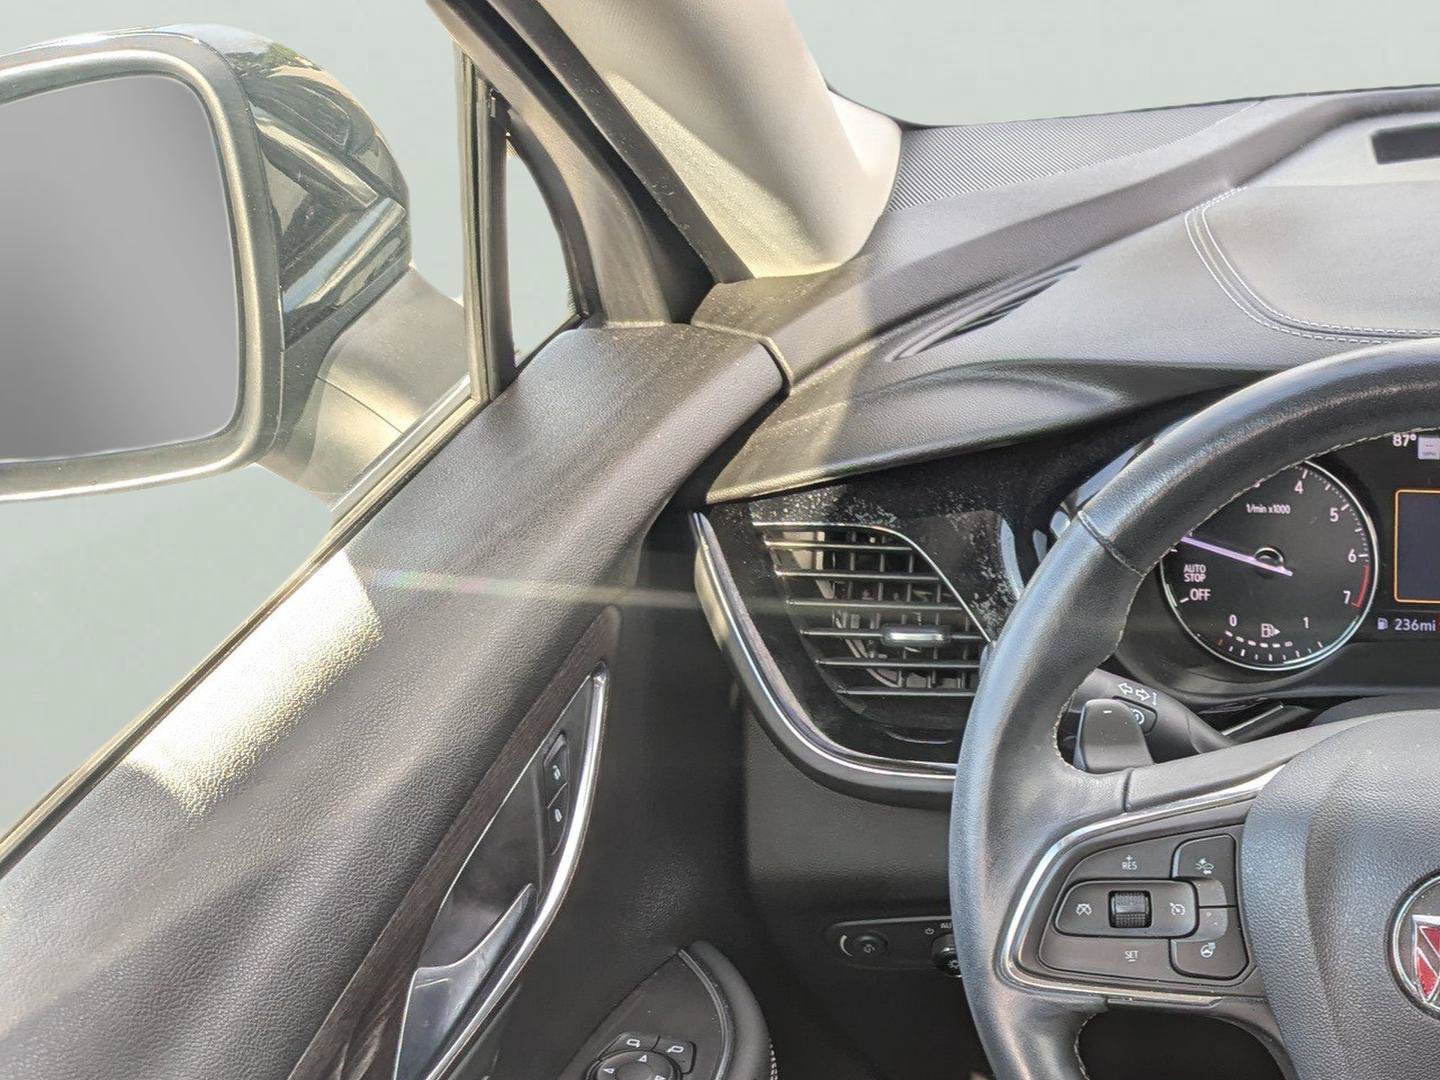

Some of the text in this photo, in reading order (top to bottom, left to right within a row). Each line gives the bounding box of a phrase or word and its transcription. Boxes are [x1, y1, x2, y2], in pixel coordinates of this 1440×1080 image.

[1294, 480, 1303, 494] 4
[1268, 504, 1291, 514] x1000
[1329, 509, 1339, 522] 5
[1347, 548, 1357, 563] 6
[1183, 564, 1207, 574] AUTO
[1183, 573, 1207, 583] STOP
[1189, 588, 1211, 602] OFF
[1343, 590, 1351, 604] 7
[1229, 615, 1238, 627] 0
[1303, 616, 1310, 629] 1
[1122, 860, 1138, 871] RES
[1125, 950, 1139, 960] SET
